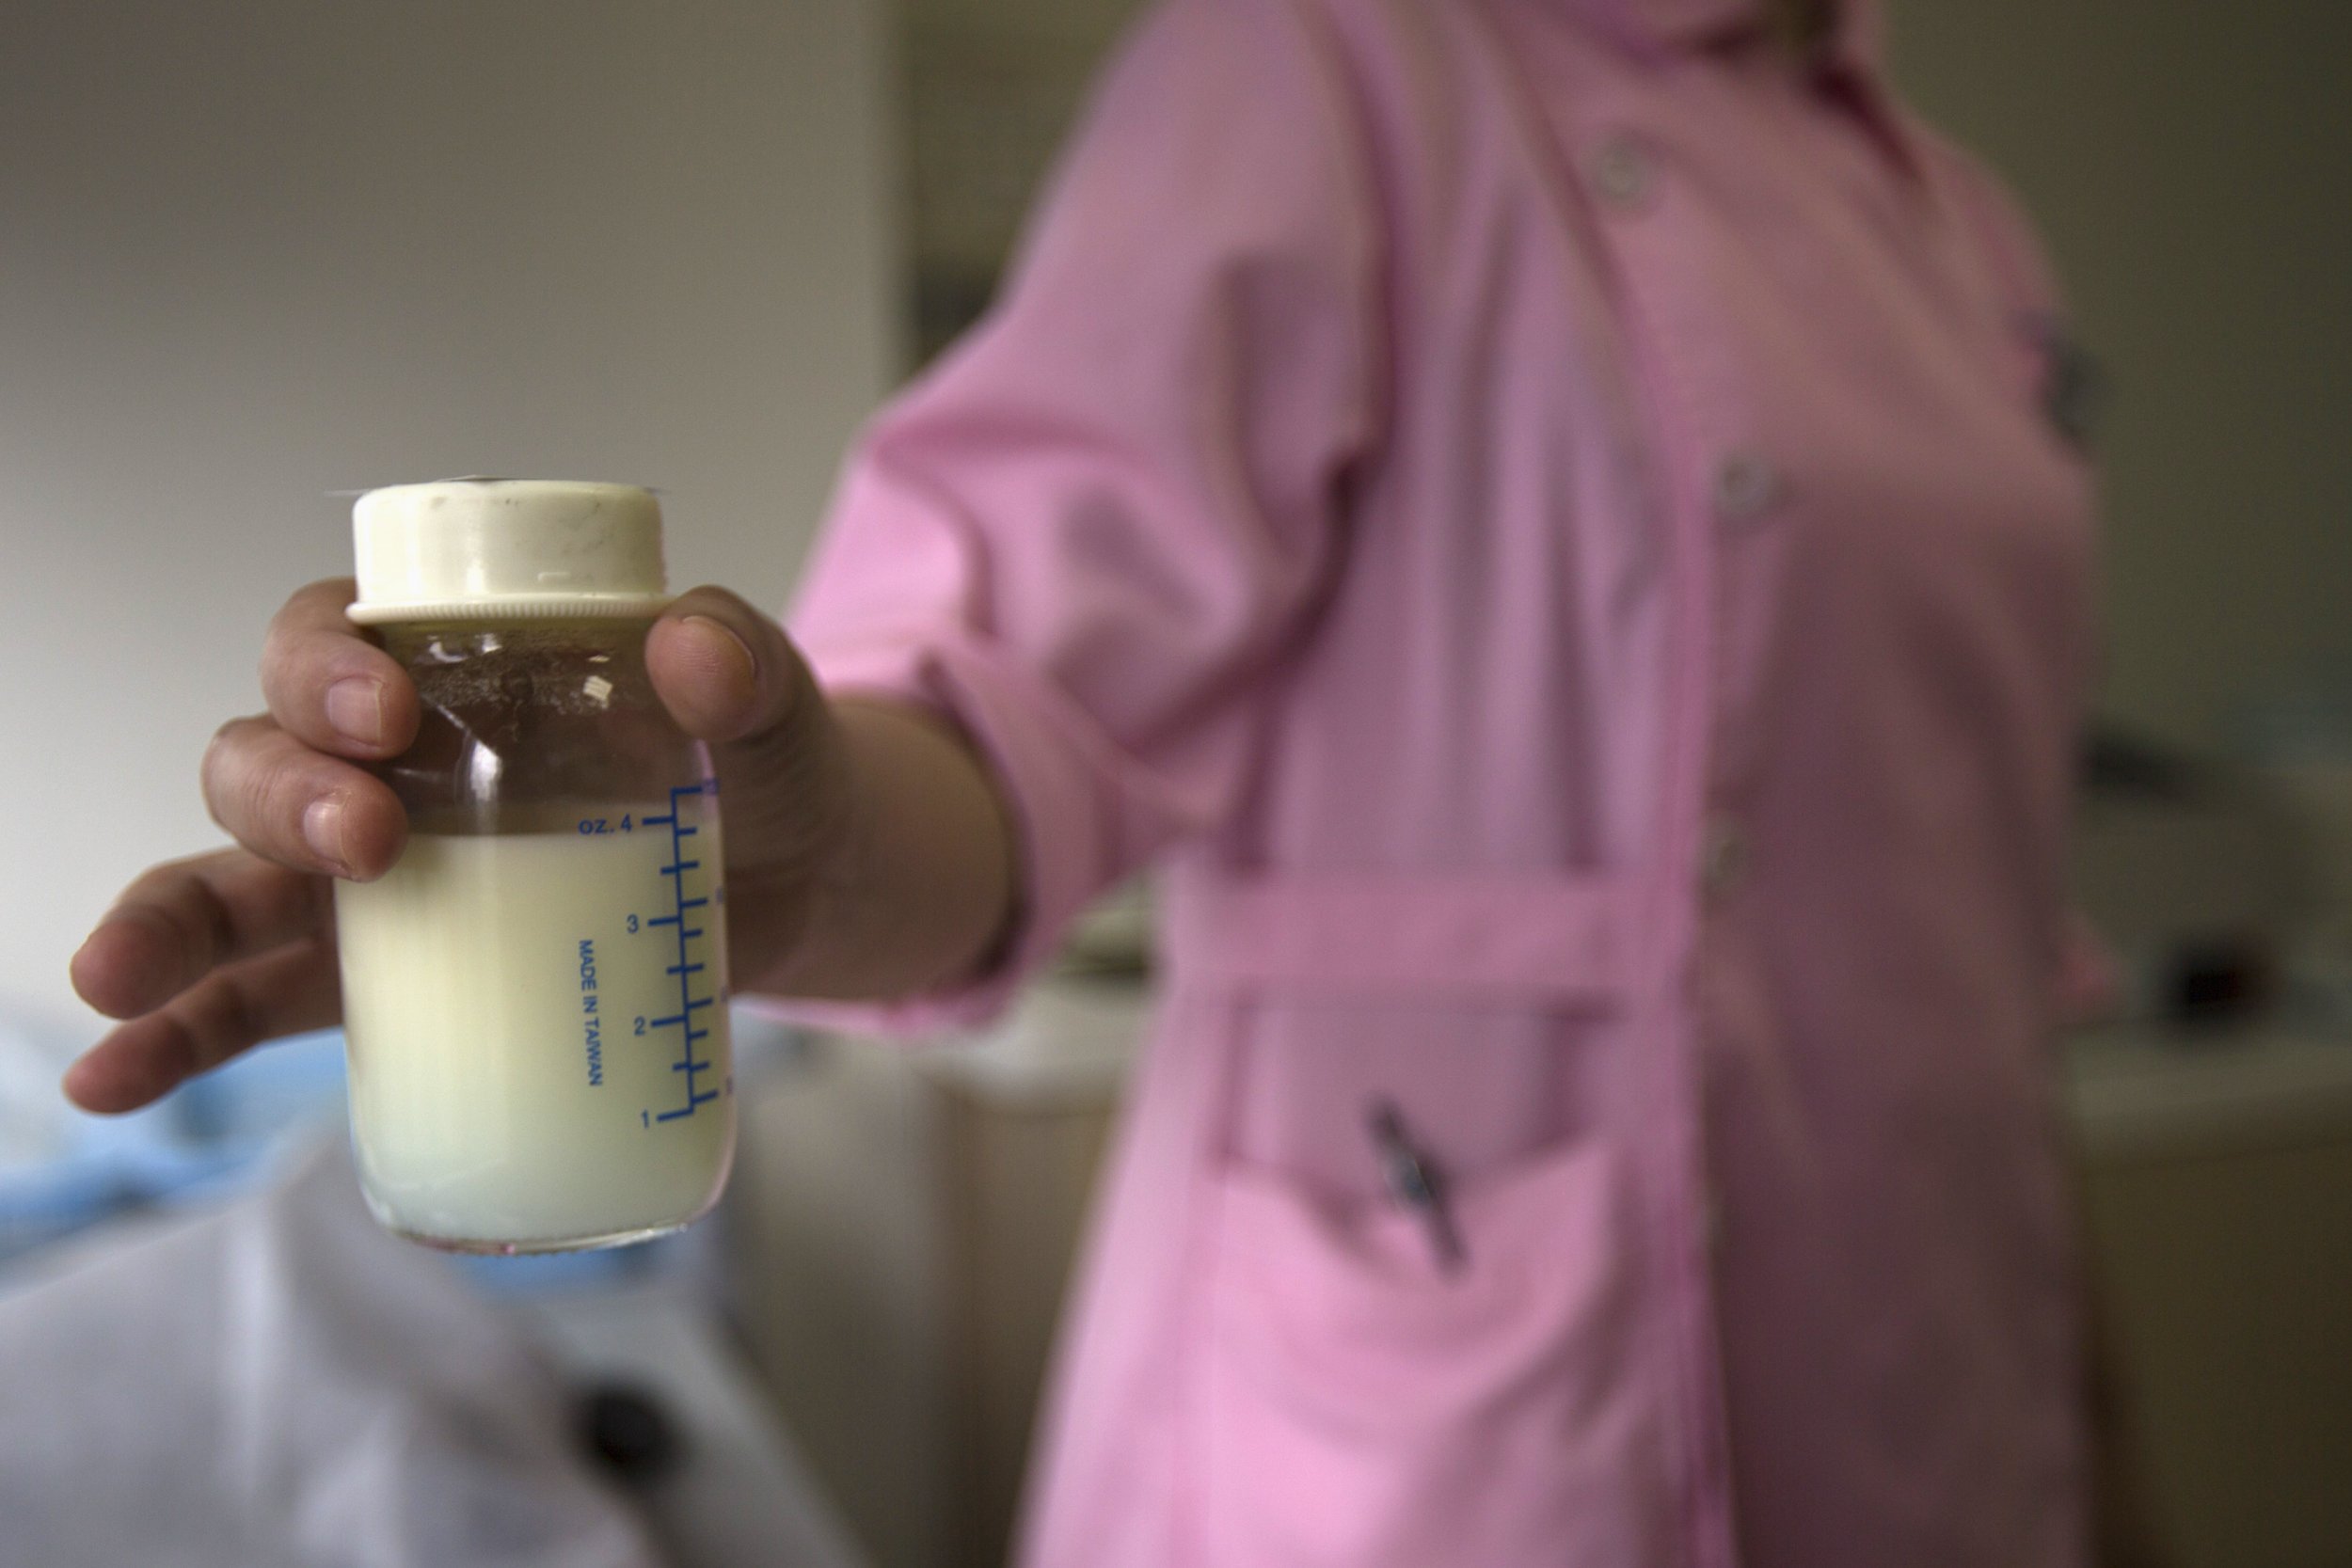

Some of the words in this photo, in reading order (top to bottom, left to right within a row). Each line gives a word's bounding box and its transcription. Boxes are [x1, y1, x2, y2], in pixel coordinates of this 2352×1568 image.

[578, 818, 615, 835] oz.
[619, 814, 633, 833] 4
[626, 914, 640, 935] 3
[579, 939, 597, 991] MADE
[582, 995, 598, 1015] IN
[633, 1016, 646, 1037] 2
[584, 1017, 604, 1087] TAIWAN
[641, 1109, 650, 1129] 1
